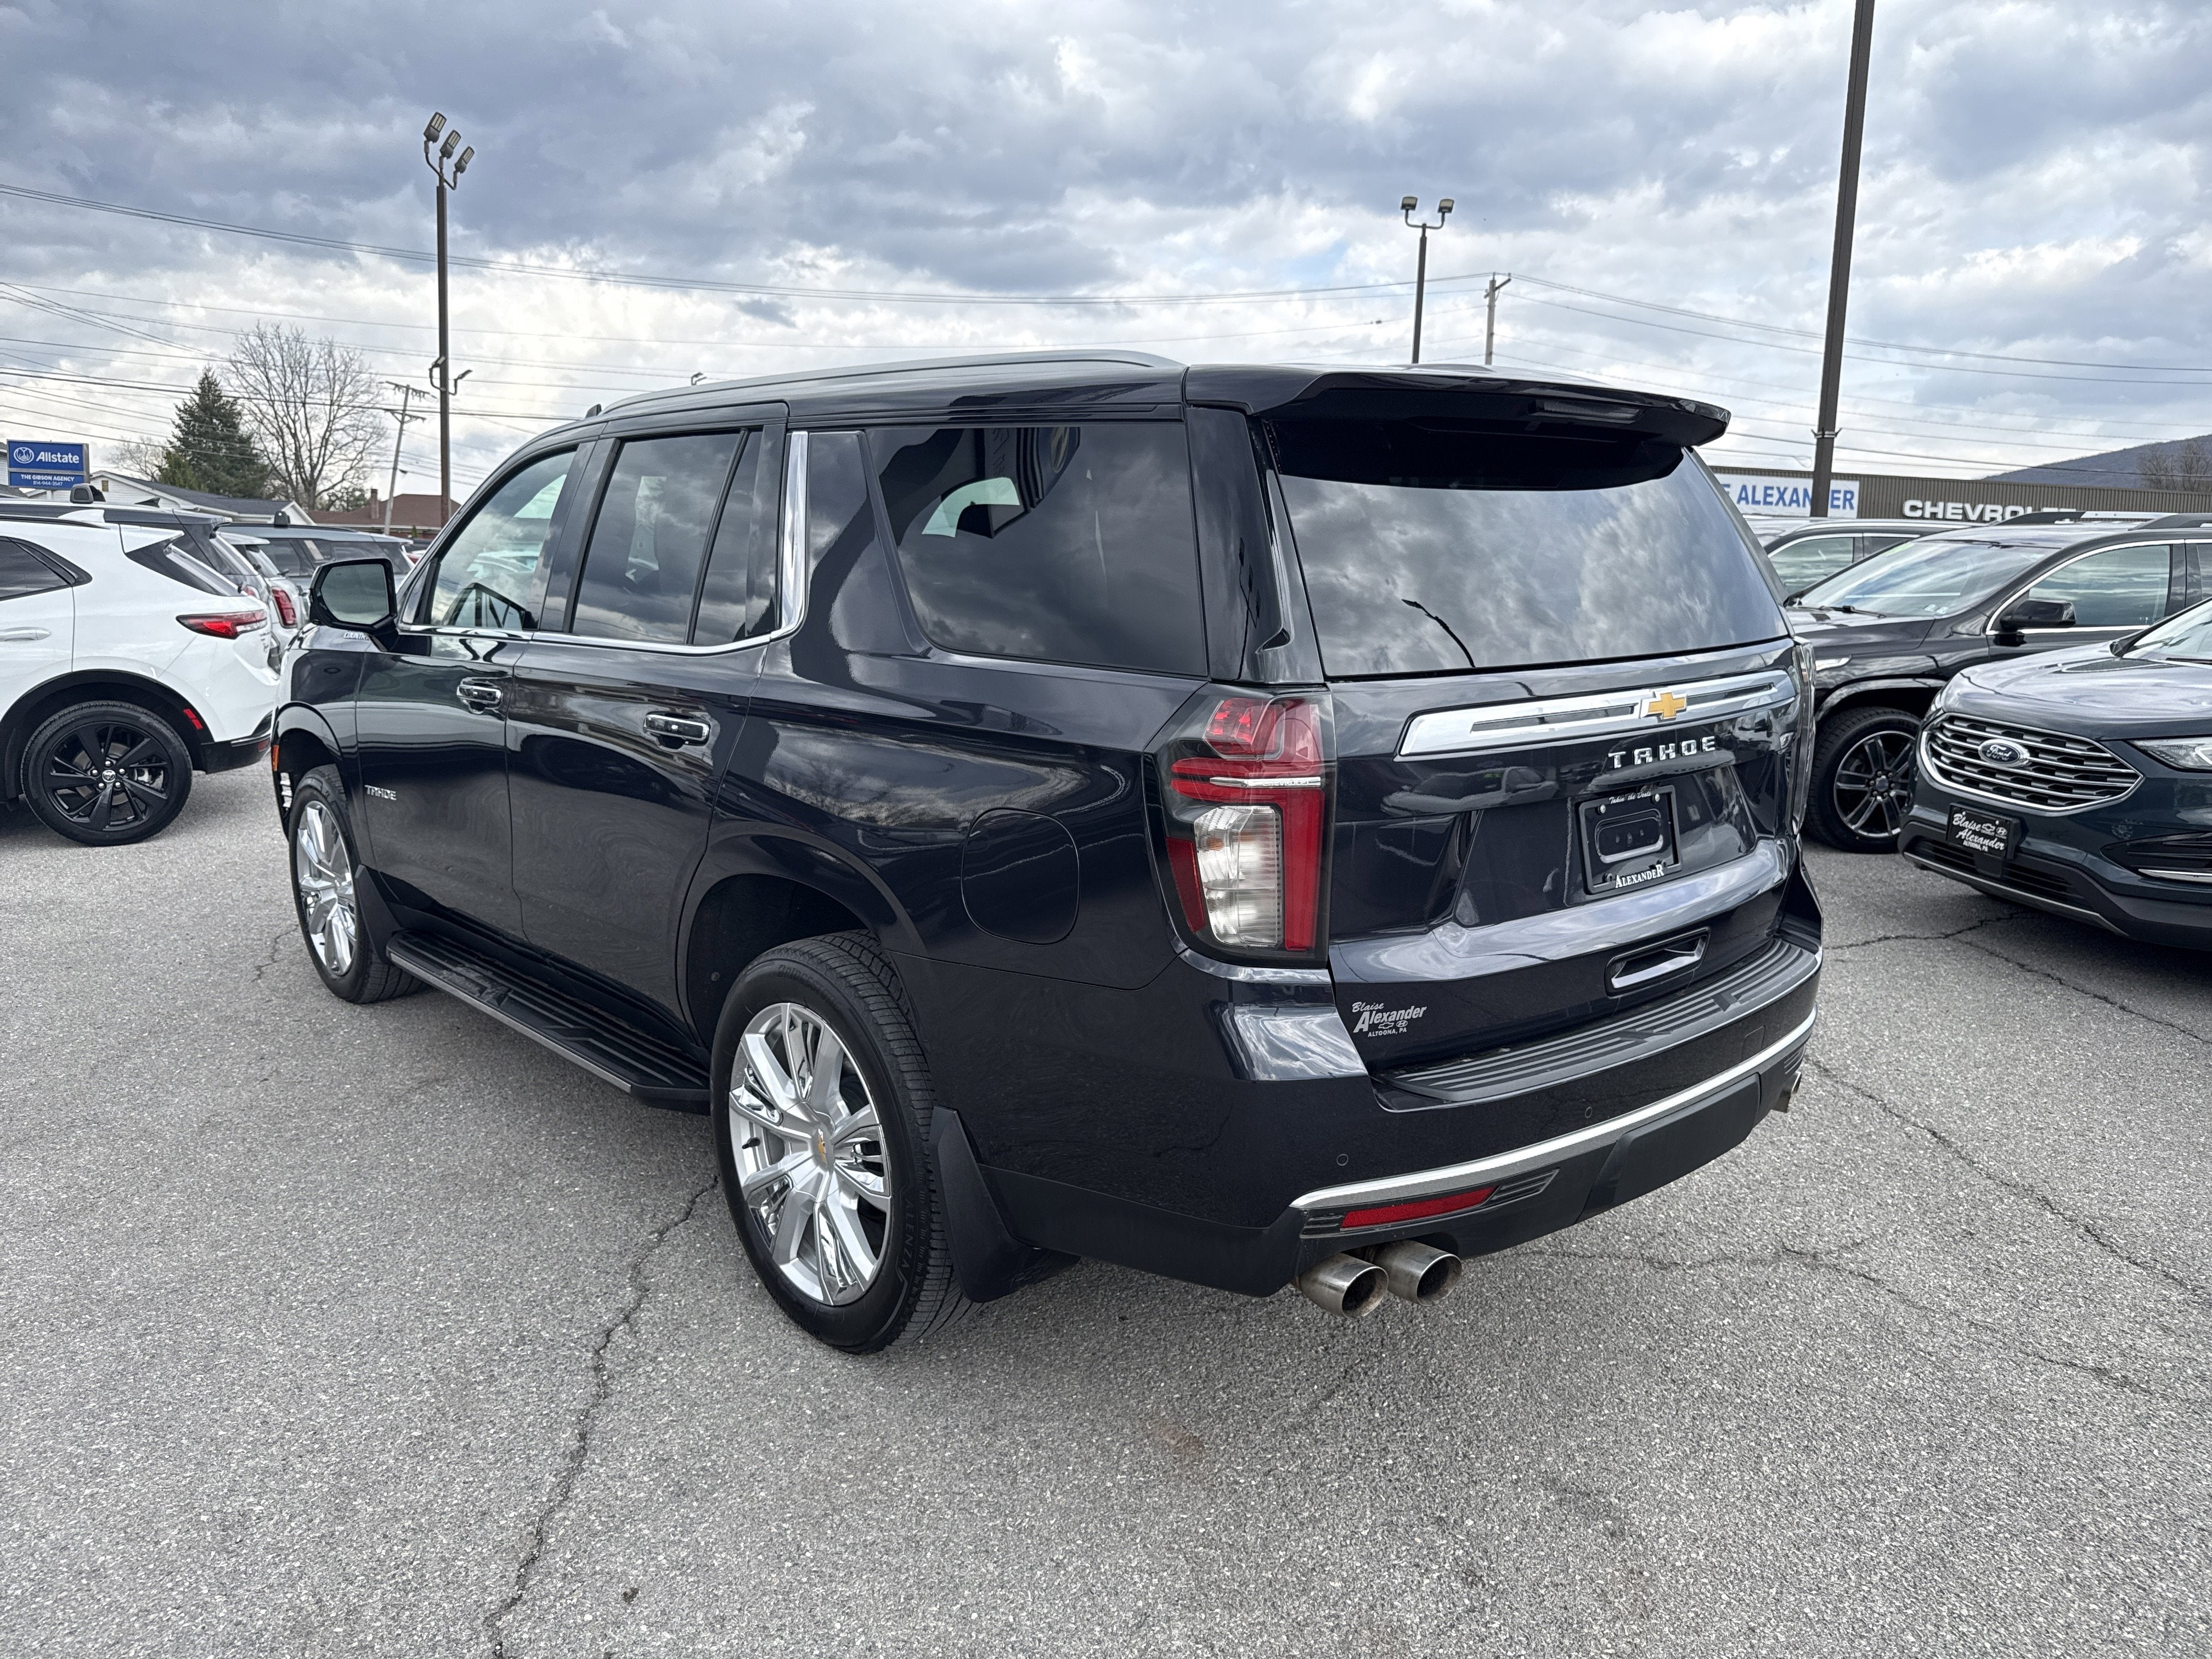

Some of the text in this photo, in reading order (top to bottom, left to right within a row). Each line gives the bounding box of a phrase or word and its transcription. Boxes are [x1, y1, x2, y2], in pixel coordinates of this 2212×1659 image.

[36, 452, 79, 464] Allstate
[1736, 484, 1854, 510] ALEXANER
[1903, 499, 2076, 522] CHEVRO
[1607, 736, 1716, 769] TAHOE
[1986, 744, 2012, 761] Ford
[364, 785, 397, 800] TAHOE
[1953, 813, 1981, 832] Blaise
[1955, 828, 2005, 850] Alexander
[1615, 864, 1664, 888] ALEXANDER
[1352, 1001, 1384, 1012] Blaise
[1352, 1005, 1427, 1033] Alexander
[1367, 1029, 1398, 1037] ALTOONA,
